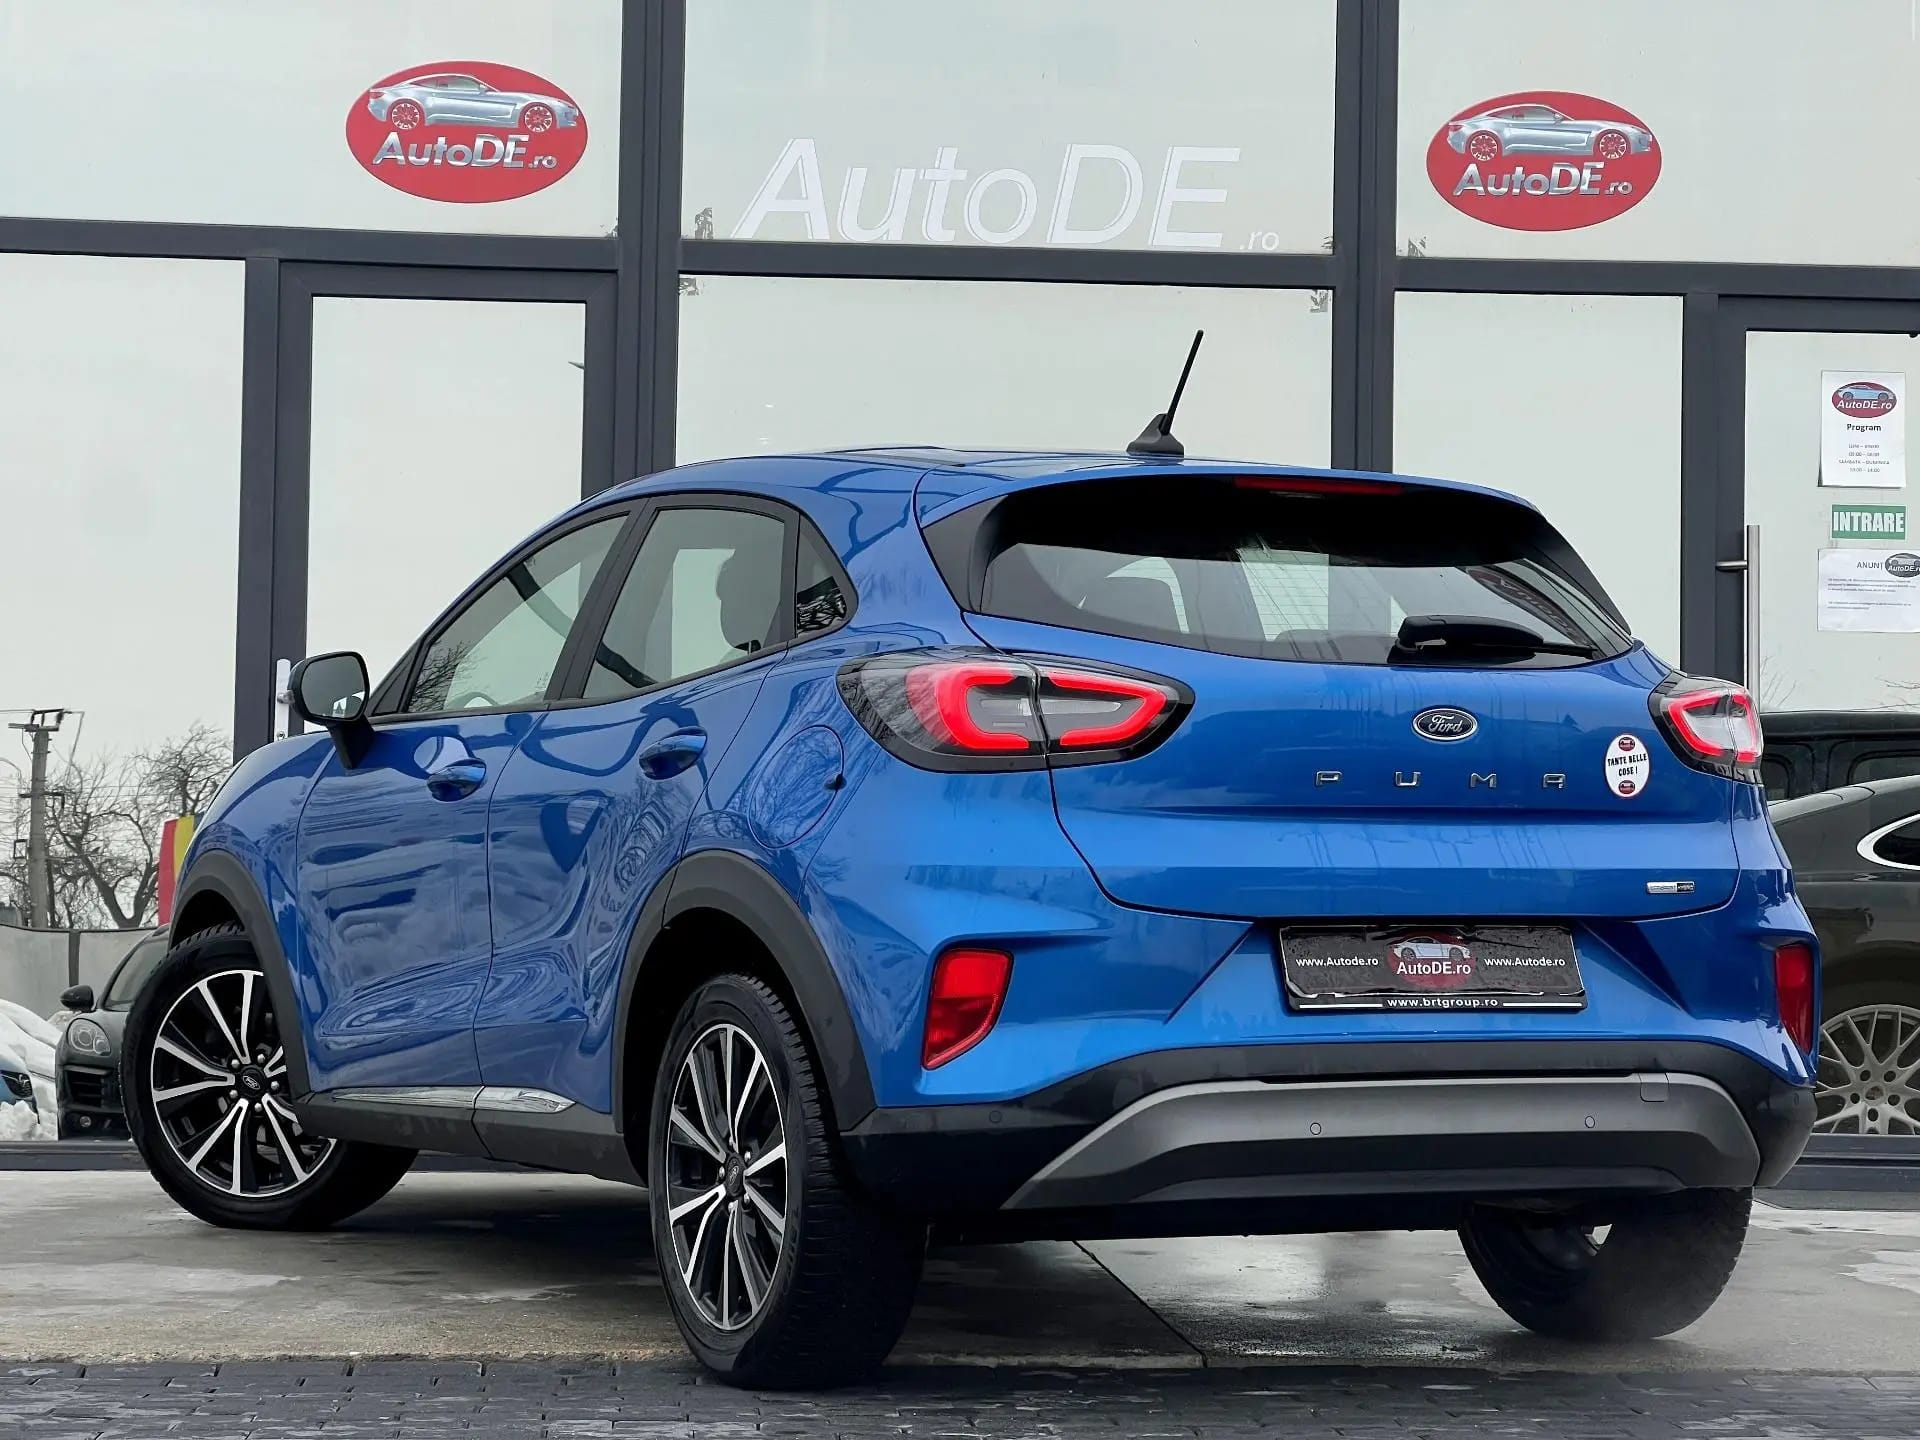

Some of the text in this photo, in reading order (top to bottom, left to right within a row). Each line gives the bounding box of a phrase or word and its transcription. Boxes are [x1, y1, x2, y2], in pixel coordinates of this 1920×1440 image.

[1836, 399, 1893, 410] AutoDE.ro
[1846, 423, 1882, 433] Program
[1833, 511, 1905, 533] INTRARE
[1888, 564, 1920, 572] AutoDE.r
[1428, 714, 1463, 733] Ford
[1607, 753, 1648, 767] TANTE BELLE
[1618, 766, 1634, 777] COSE
[1315, 770, 1567, 789] PUMA
[1295, 956, 1379, 967] www.Autode.ro
[1484, 957, 1566, 967] www.Autode.ro
[1396, 961, 1472, 975] AutoDE.ro
[1387, 997, 1498, 1008] www.brtgroup.ro
